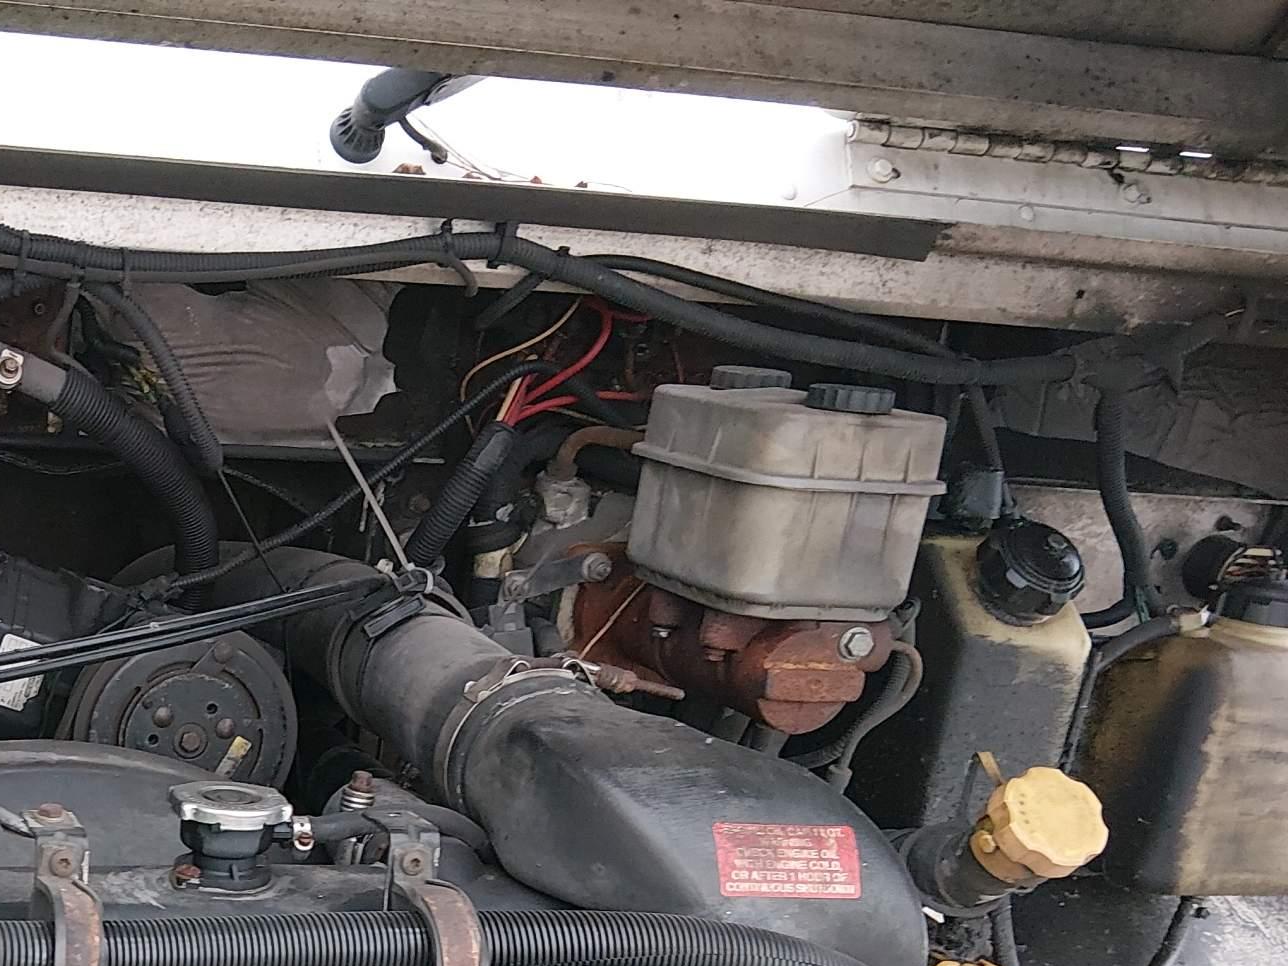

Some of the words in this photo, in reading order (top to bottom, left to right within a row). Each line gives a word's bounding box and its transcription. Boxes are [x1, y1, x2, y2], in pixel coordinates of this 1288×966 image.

[736, 847, 775, 857] CHECK
[776, 848, 819, 859] ENGINE
[767, 859, 808, 870] ENGINE
[731, 870, 750, 881] OR
[751, 870, 788, 881] AFTER
[797, 872, 831, 882] HOUR
[832, 872, 850, 882] OF
[725, 882, 795, 893] CONTINUOUS
